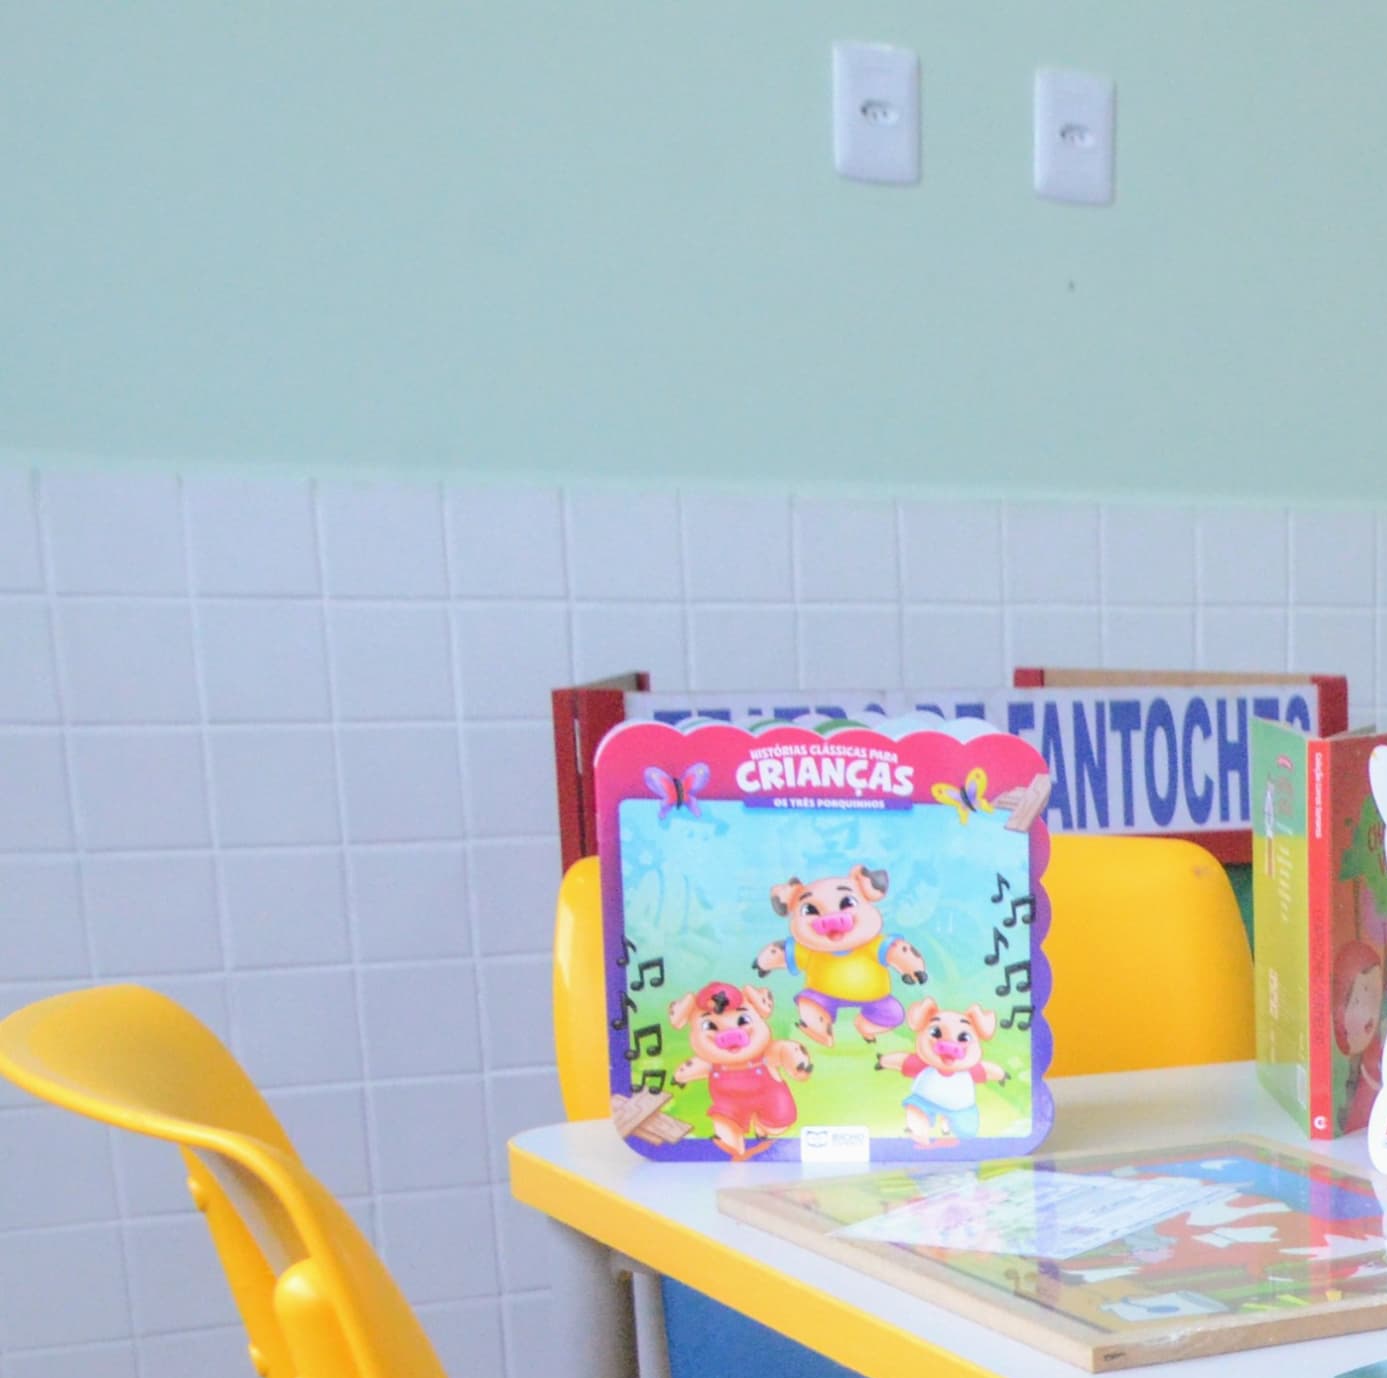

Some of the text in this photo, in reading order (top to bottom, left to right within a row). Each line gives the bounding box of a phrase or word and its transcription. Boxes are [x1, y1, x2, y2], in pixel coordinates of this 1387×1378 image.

[750, 741, 898, 763] HISTÓRIAS CLÁSSICAS PARA
[1007, 694, 1311, 831] ANTOCH
[736, 756, 914, 797] CRIANÇAS
[774, 796, 886, 810] OS TRÊS PORQUINHOS
